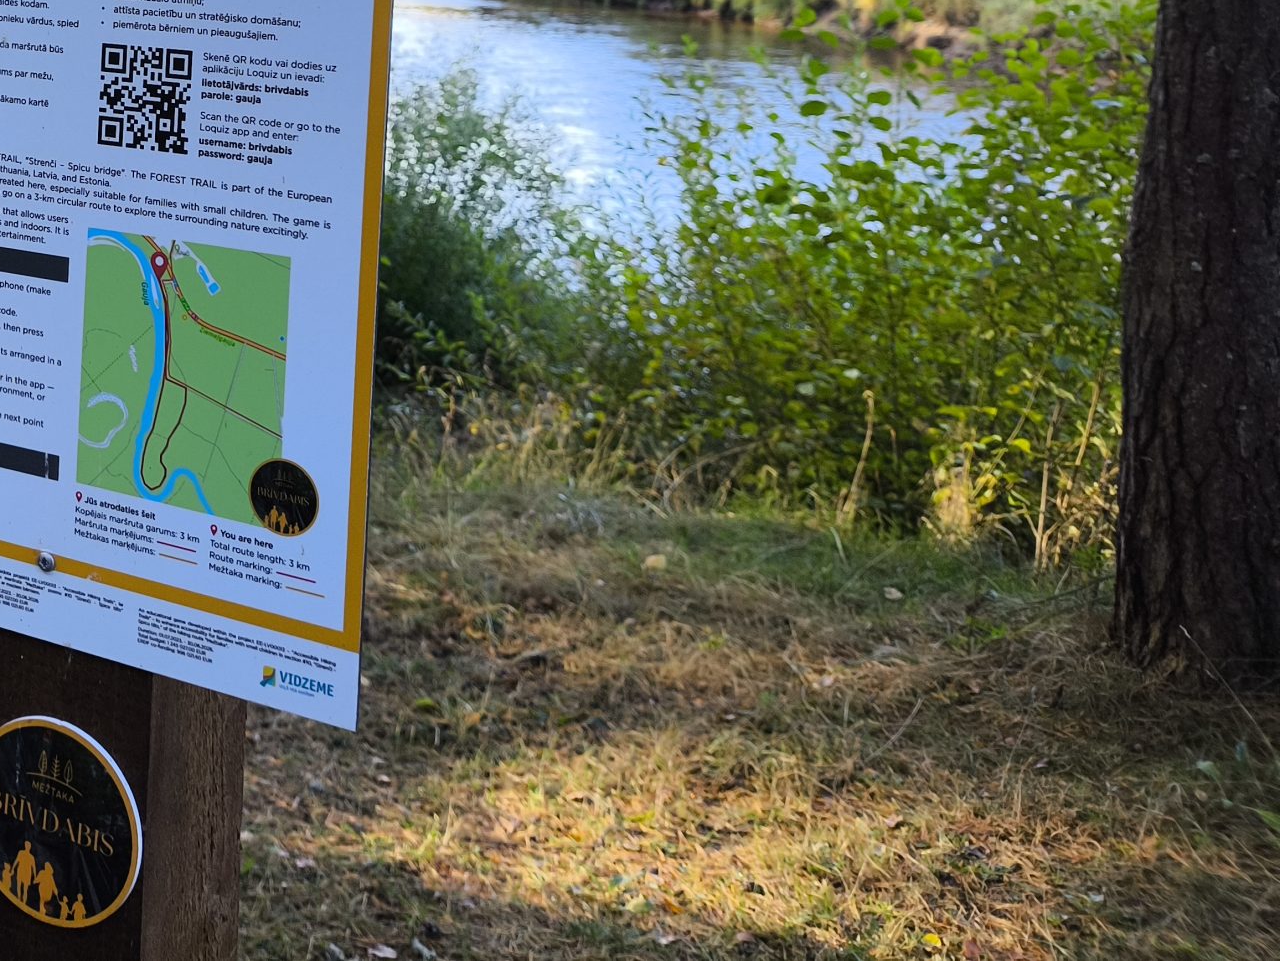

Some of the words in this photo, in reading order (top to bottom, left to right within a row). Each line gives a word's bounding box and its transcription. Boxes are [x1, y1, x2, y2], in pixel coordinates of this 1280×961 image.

[113, 5, 141, 16] attīsta
[142, 7, 183, 19] pacietību
[184, 12, 197, 20] un
[198, 11, 249, 24] stratēģisko
[250, 15, 301, 29] domāšanu;
[112, 19, 157, 32] piemērota
[158, 22, 195, 35] bērniem
[196, 28, 209, 36] un
[210, 27, 279, 41] pieaugušajiem.
[202, 51, 231, 63] Skenē
[232, 54, 247, 65] QR
[249, 56, 273, 67] kodu
[274, 59, 289, 68] vai
[290, 60, 323, 72] dodies
[324, 65, 337, 73] uz
[201, 64, 245, 77] aplikāciju
[246, 67, 278, 79] Loquiz
[279, 72, 293, 80] un
[294, 71, 325, 83] ievadi:
[200, 91, 234, 102] parole:
[235, 94, 262, 105] gauja
[201, 77, 262, 93] lietotājvārds:
[264, 83, 309, 97] brivdabis
[199, 122, 230, 135] Loquiz
[231, 127, 251, 138] app
[251, 129, 270, 139] and
[200, 110, 222, 122] Scan
[224, 113, 240, 124] the
[241, 115, 257, 126] QR
[258, 118, 282, 129] code
[283, 121, 295, 129] or
[296, 123, 310, 132] go
[311, 123, 323, 133] to
[324, 124, 341, 135] the
[197, 149, 245, 162] password:
[246, 155, 273, 166] gauja
[198, 138, 246, 150] username:
[247, 141, 293, 156] brivdabis
[67, 161, 91, 173] Spicu
[130, 169, 147, 180] The
[149, 172, 187, 185] FOREST
[189, 177, 218, 190] TRAIL
[220, 181, 229, 191] is
[231, 184, 251, 194] part
[254, 186, 265, 195] of
[267, 187, 284, 198] the
[286, 189, 333, 204] European
[220, 529, 237, 541] You
[237, 535, 253, 545] are
[253, 537, 274, 550] here
[208, 550, 235, 565] Route
[235, 559, 273, 575] marking:
[210, 538, 231, 552] Total
[231, 546, 255, 558] route
[256, 550, 287, 566] length:
[288, 558, 295, 568] 3
[296, 560, 311, 572] km
[208, 562, 244, 579] Mežtaka
[245, 573, 283, 590] marking:
[279, 670, 334, 698] VIDZEME
[31, 780, 75, 804] MEŽTAKA
